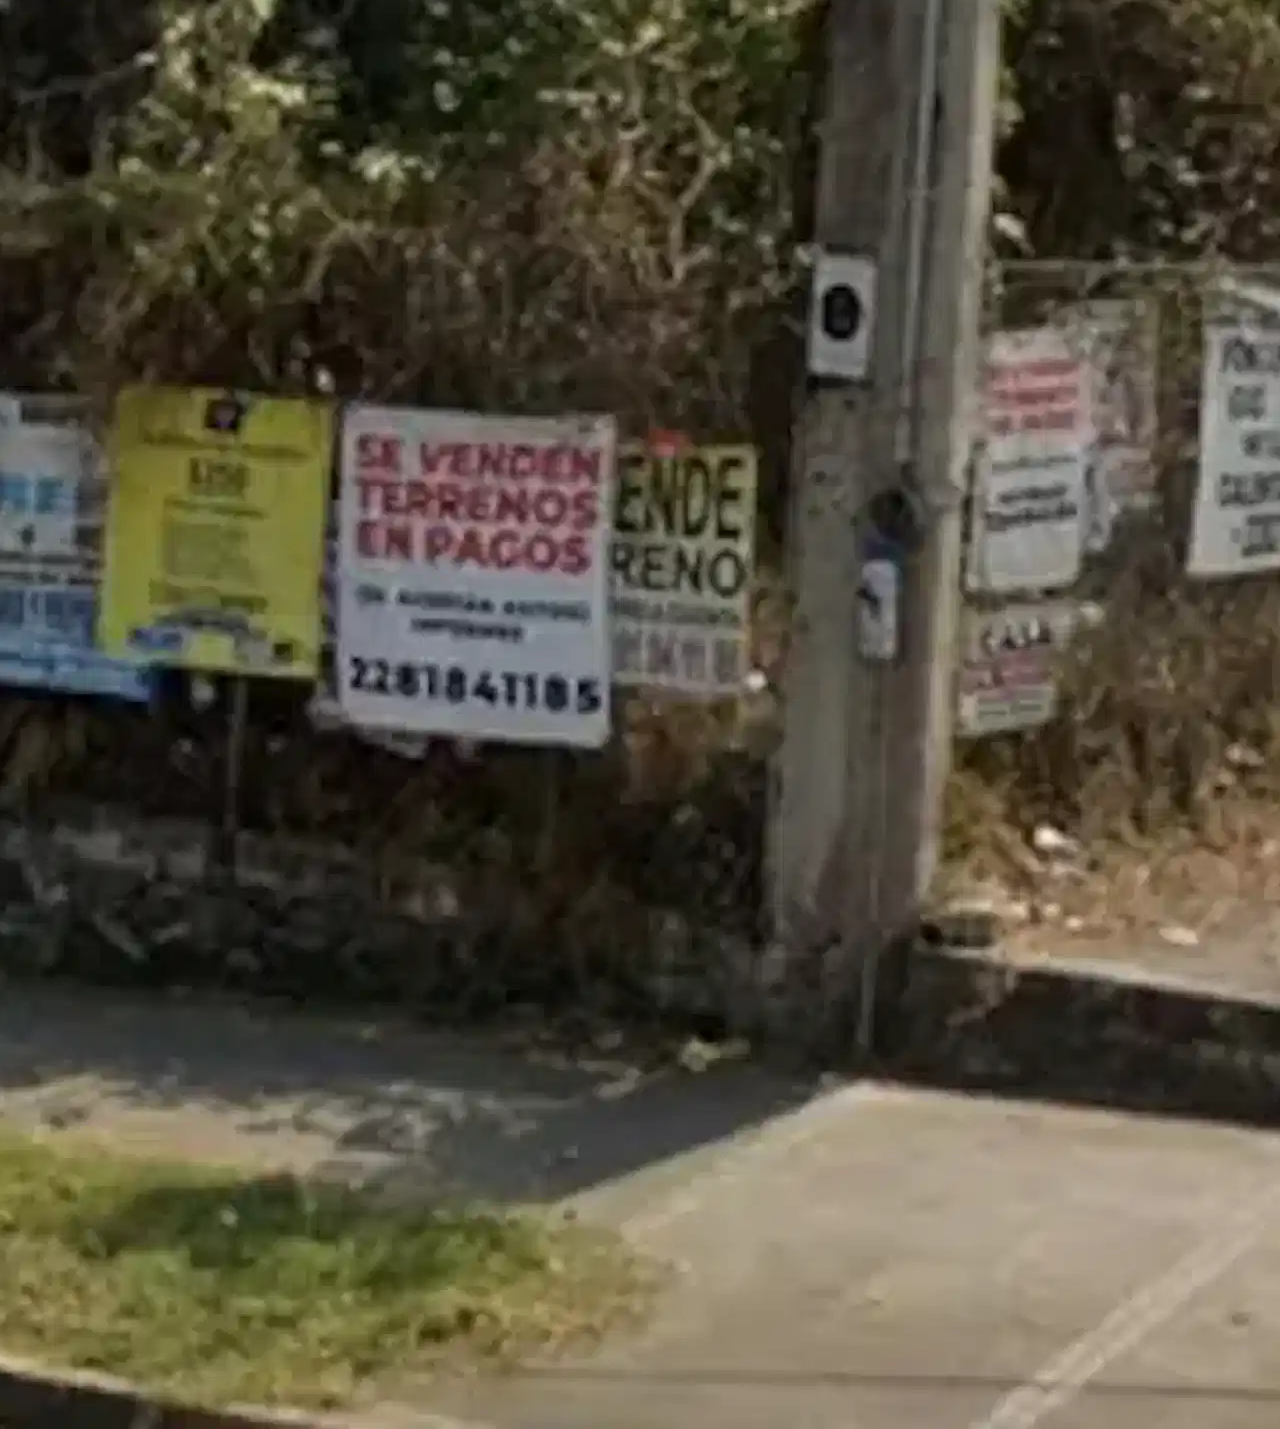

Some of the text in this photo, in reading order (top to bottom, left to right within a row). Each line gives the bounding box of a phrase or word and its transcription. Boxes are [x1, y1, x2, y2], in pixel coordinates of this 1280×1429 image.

[355, 432, 401, 470] SE
[418, 439, 602, 484] VENDEN
[357, 476, 600, 530] TERRENOS
[356, 520, 593, 576] EN PAGOS
